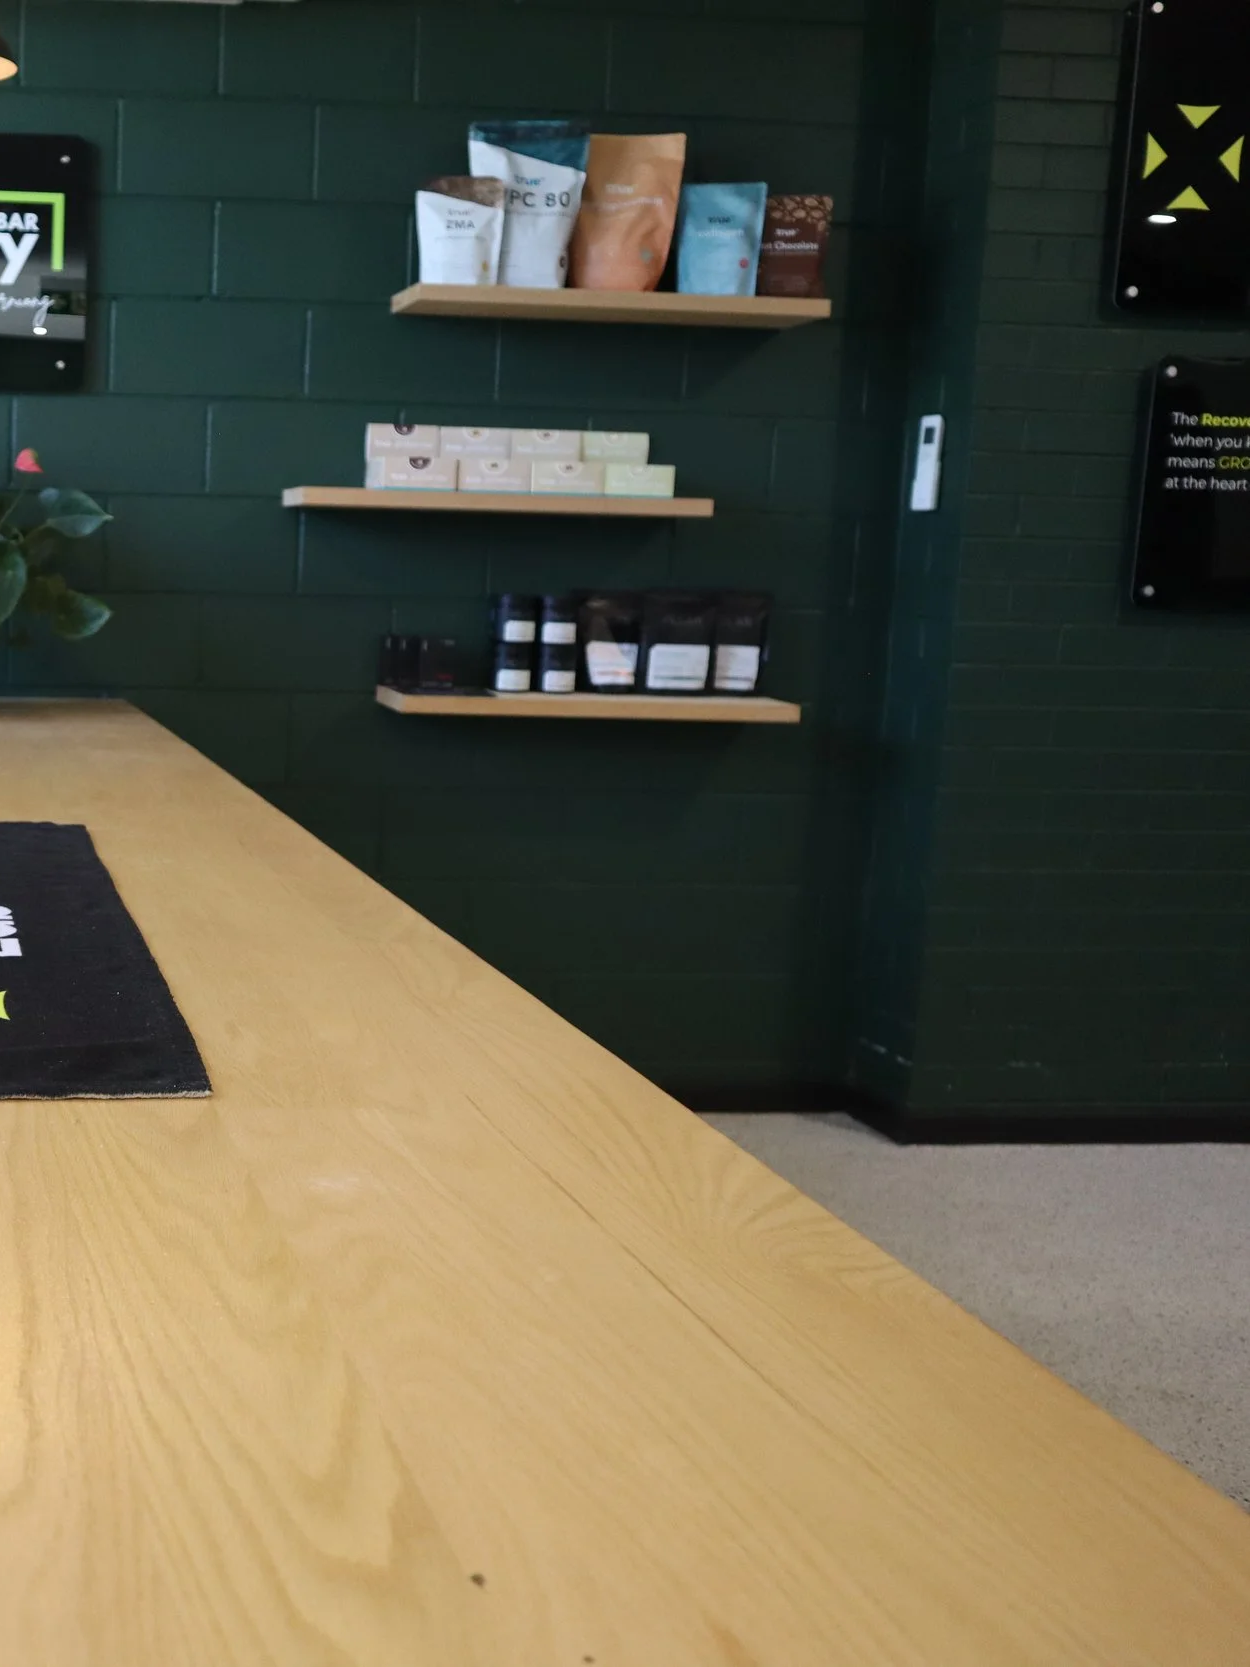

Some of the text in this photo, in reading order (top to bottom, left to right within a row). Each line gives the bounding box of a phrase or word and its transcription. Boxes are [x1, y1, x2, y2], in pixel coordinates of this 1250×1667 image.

[544, 191, 570, 208] 80
[1172, 411, 1198, 426] The
[1214, 437, 1242, 451] you
[1167, 456, 1216, 469] means
[1165, 475, 1247, 491] at the heart
